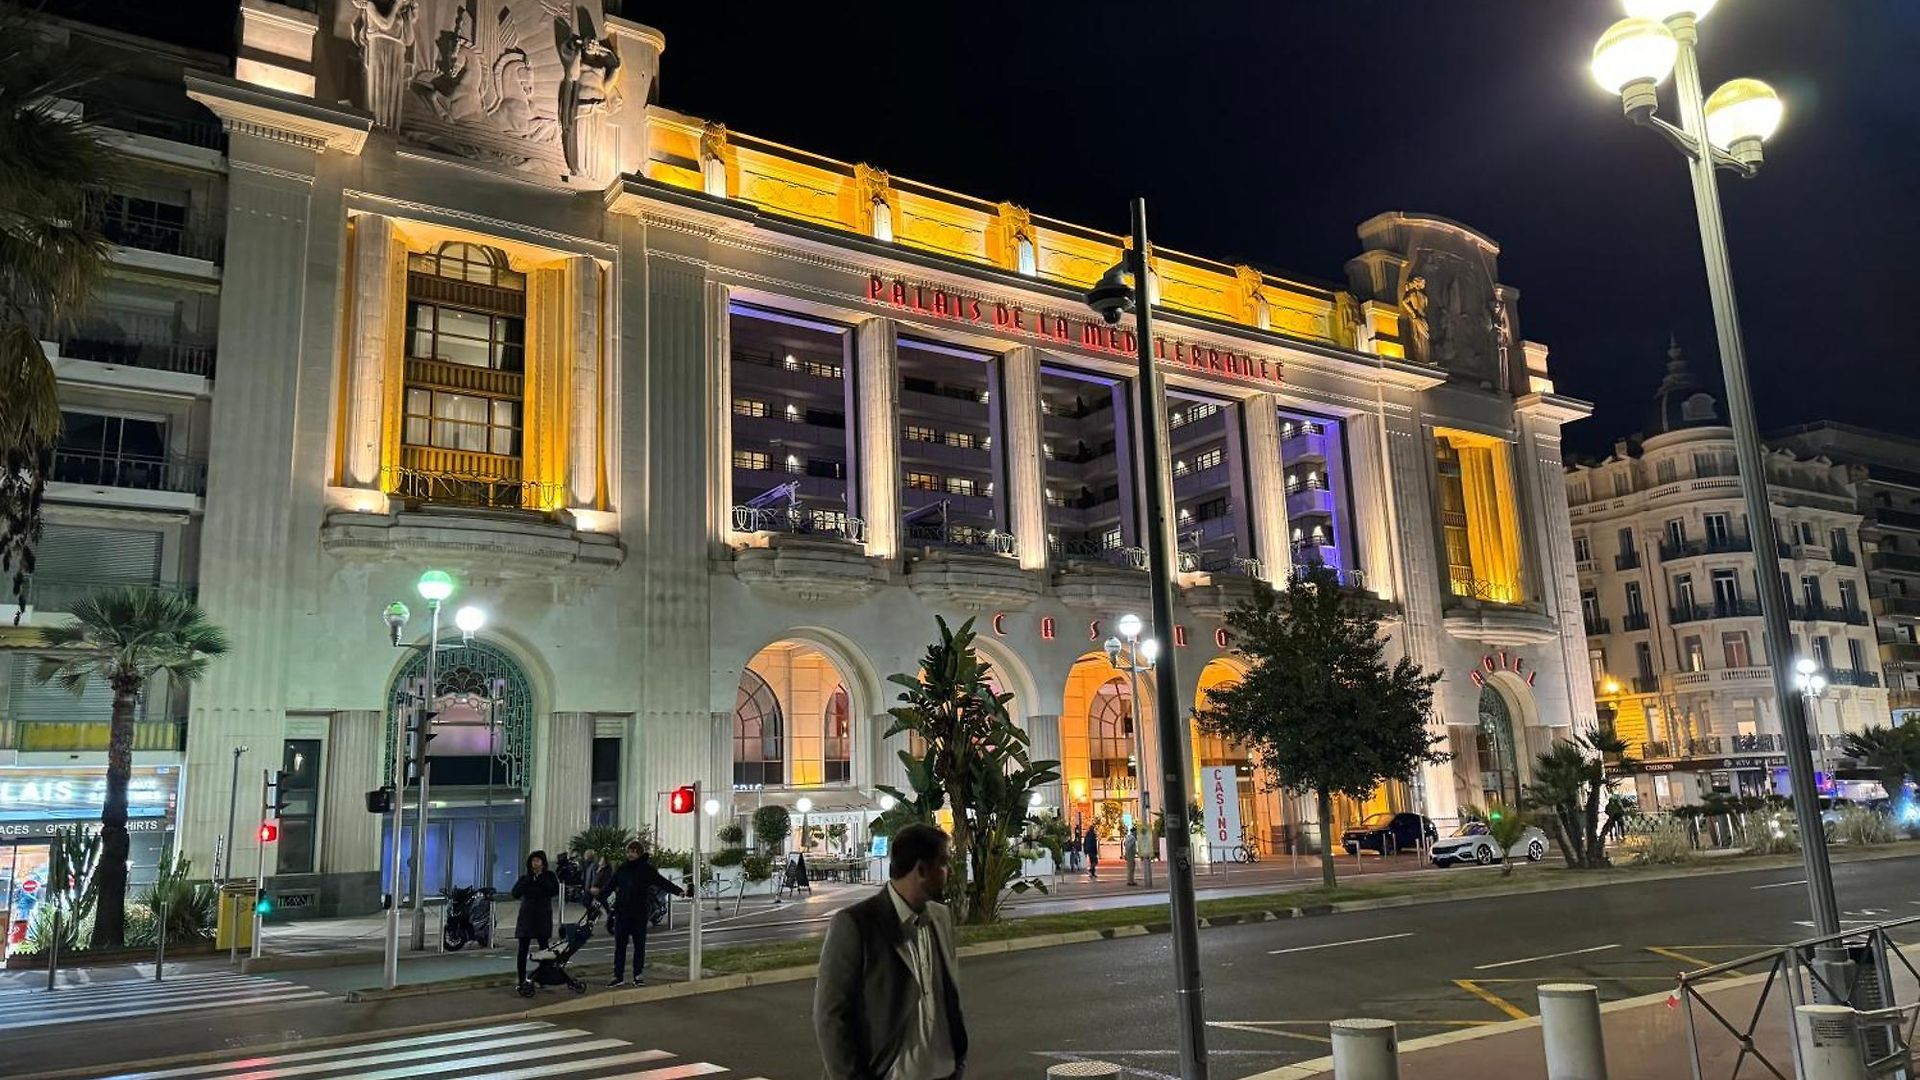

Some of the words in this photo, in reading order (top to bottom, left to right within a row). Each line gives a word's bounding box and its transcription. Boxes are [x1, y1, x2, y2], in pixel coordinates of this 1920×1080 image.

[867, 275, 982, 324] PALAIS
[993, 303, 1025, 331] DE
[1036, 312, 1069, 345] LA
[1081, 323, 1284, 384] MEDTERRANEE
[992, 613, 1229, 648] CASNO
[1214, 769, 1228, 842] CASINO
